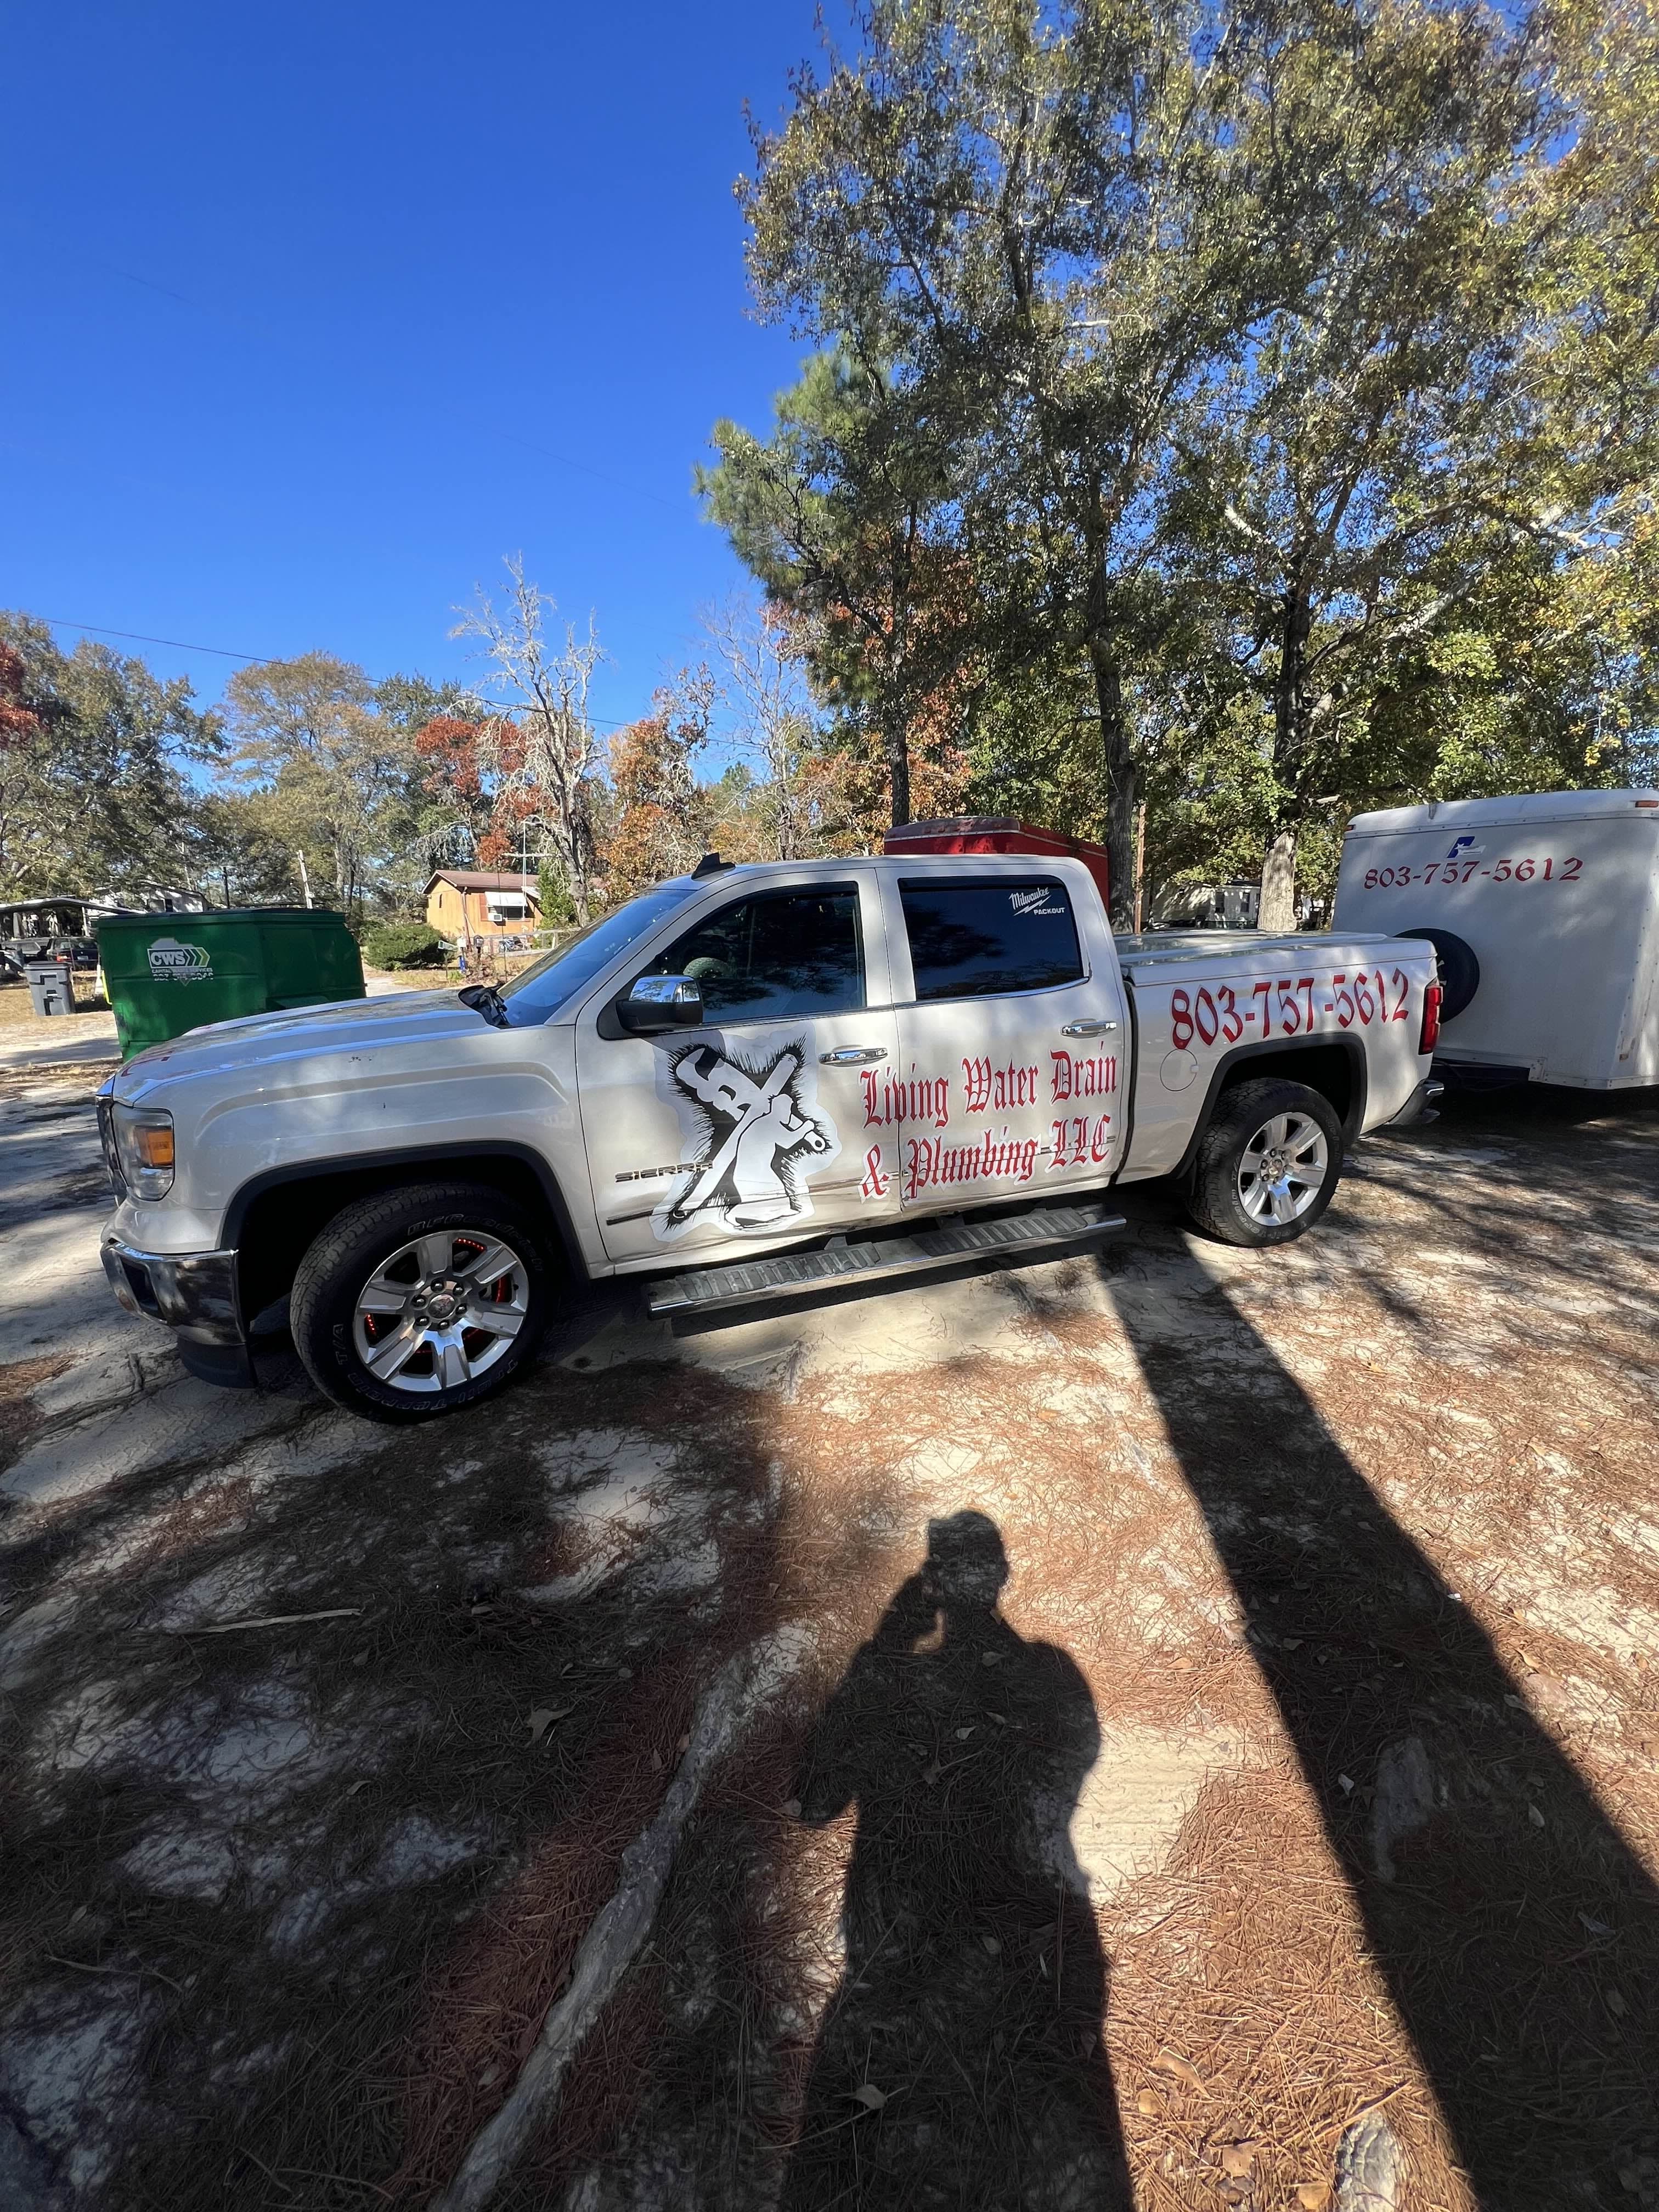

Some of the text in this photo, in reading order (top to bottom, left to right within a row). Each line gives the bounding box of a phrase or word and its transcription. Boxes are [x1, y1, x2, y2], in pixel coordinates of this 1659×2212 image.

[1364, 857, 1583, 889] 803-757-5612
[1008, 887, 1049, 910] Milwaukee
[1033, 907, 1065, 915] PACKOUT
[151, 951, 185, 966] CWS
[1171, 968, 1409, 1049] 803-757-5612
[860, 1041, 1117, 1128] Living Water Drain
[615, 1160, 713, 1183] SIERRA
[862, 1114, 1110, 1199] & Plumbing LLC
[408, 1214, 544, 1272] BFGoodrich
